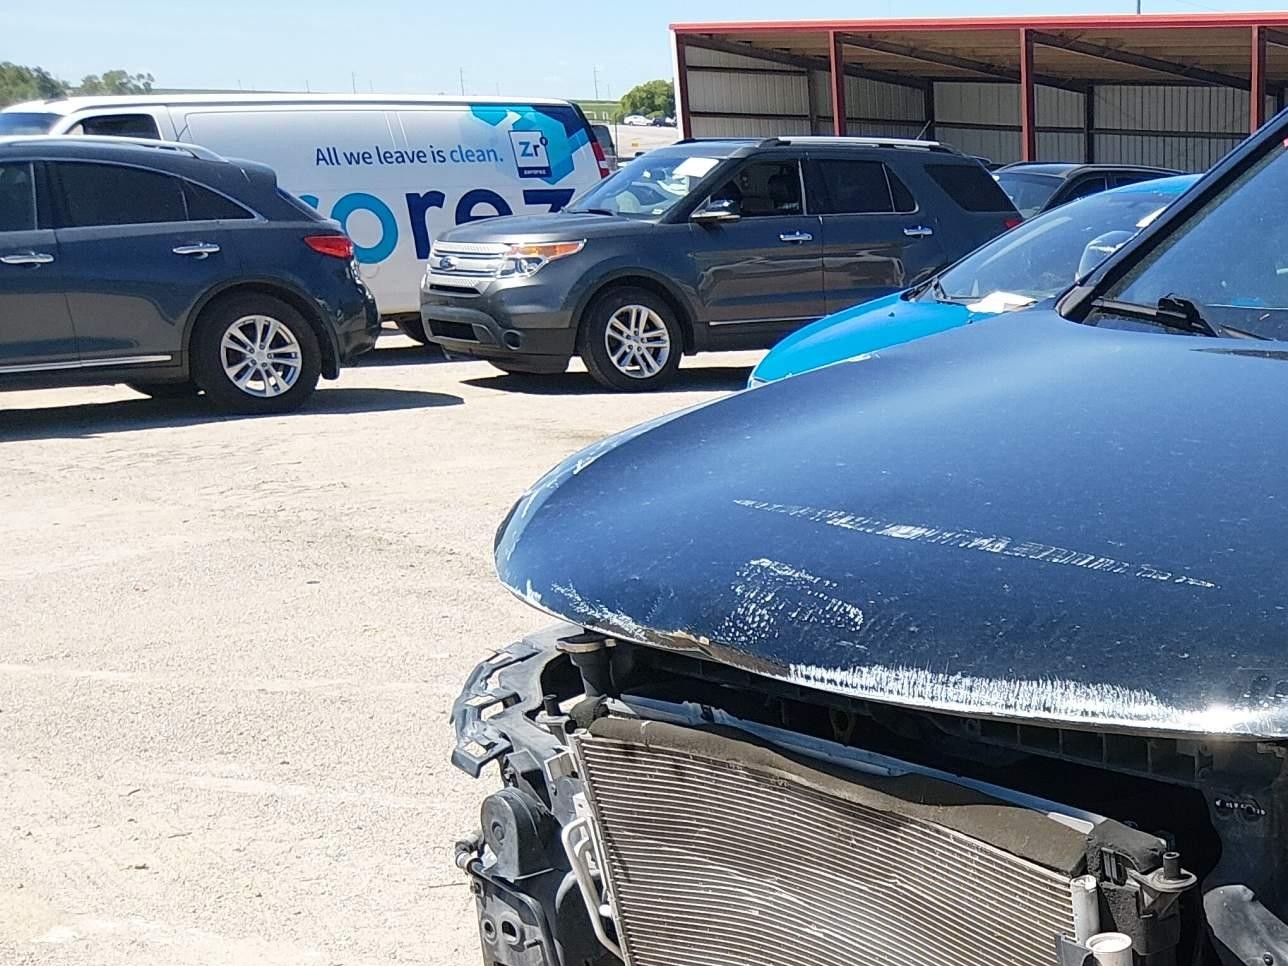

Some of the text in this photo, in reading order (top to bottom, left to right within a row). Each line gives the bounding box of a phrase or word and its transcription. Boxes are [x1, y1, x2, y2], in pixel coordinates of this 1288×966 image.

[315, 145, 504, 166] All we leave is clean.
